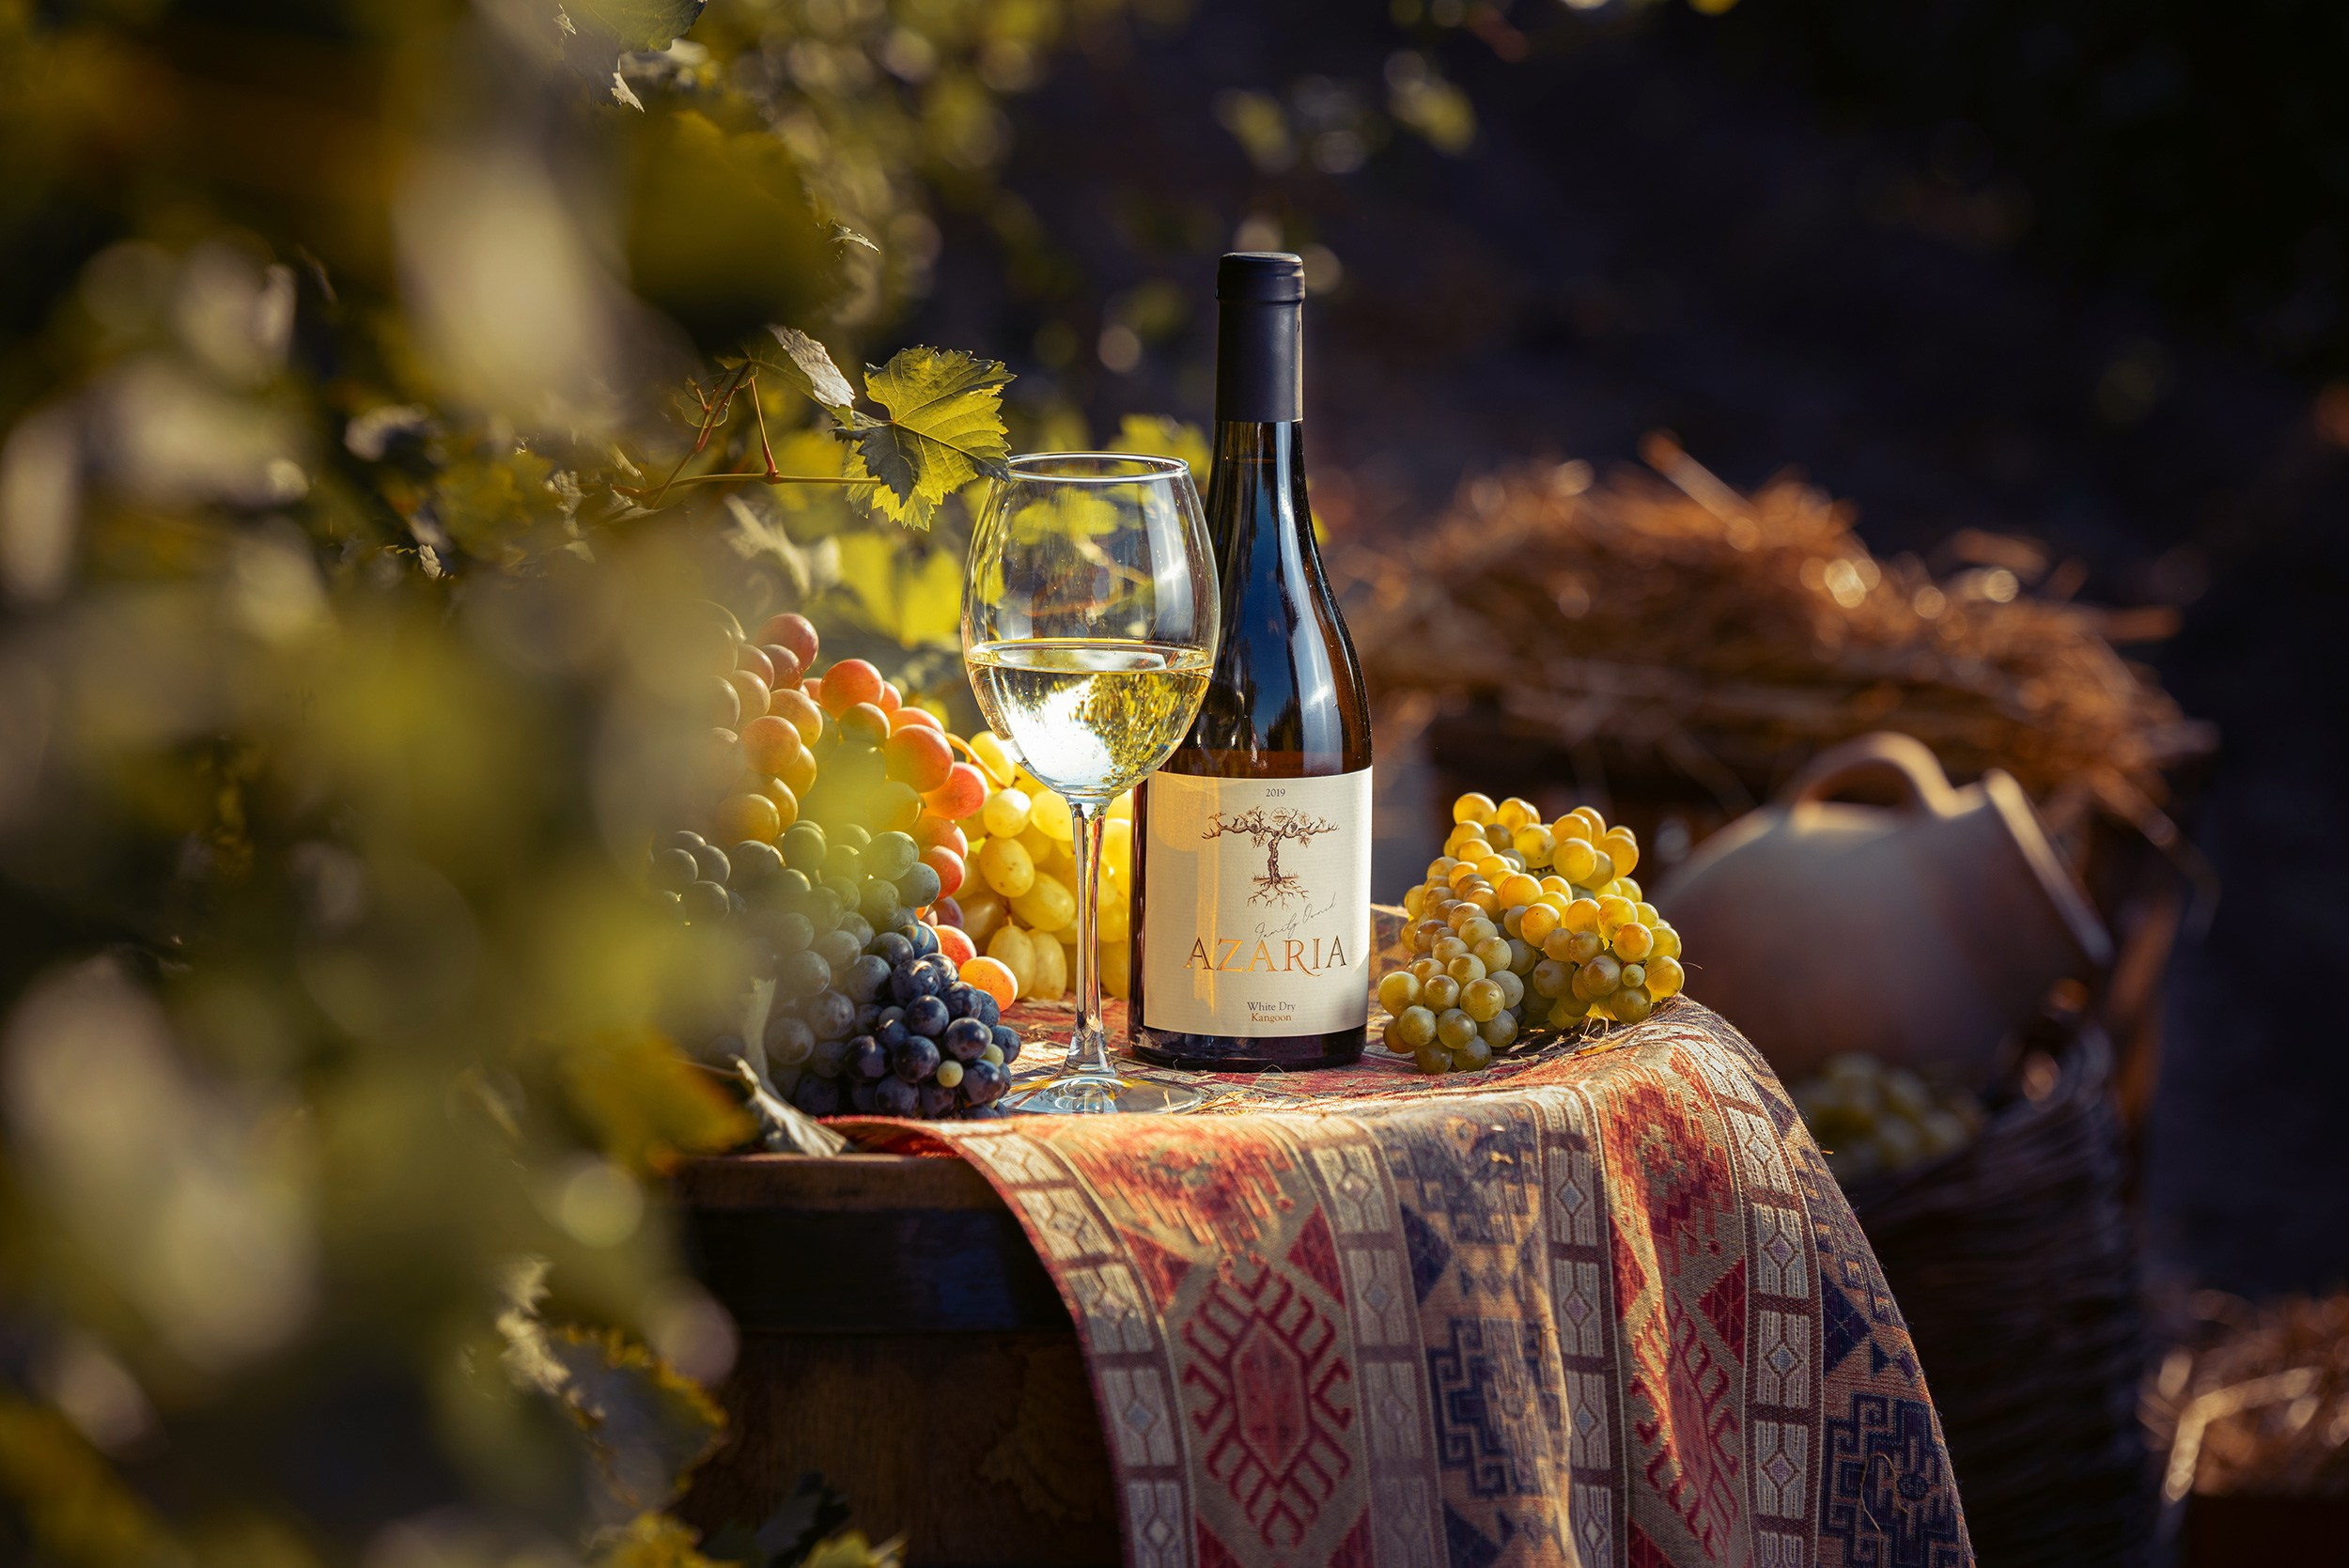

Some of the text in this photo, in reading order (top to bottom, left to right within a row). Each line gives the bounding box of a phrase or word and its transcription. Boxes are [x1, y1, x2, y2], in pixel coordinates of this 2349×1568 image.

[1266, 788, 1286, 798] 2019
[1183, 935, 1347, 977] AZARIA
[1247, 1001, 1297, 1013] White Dry
[1251, 1013, 1292, 1023] Kangoon
